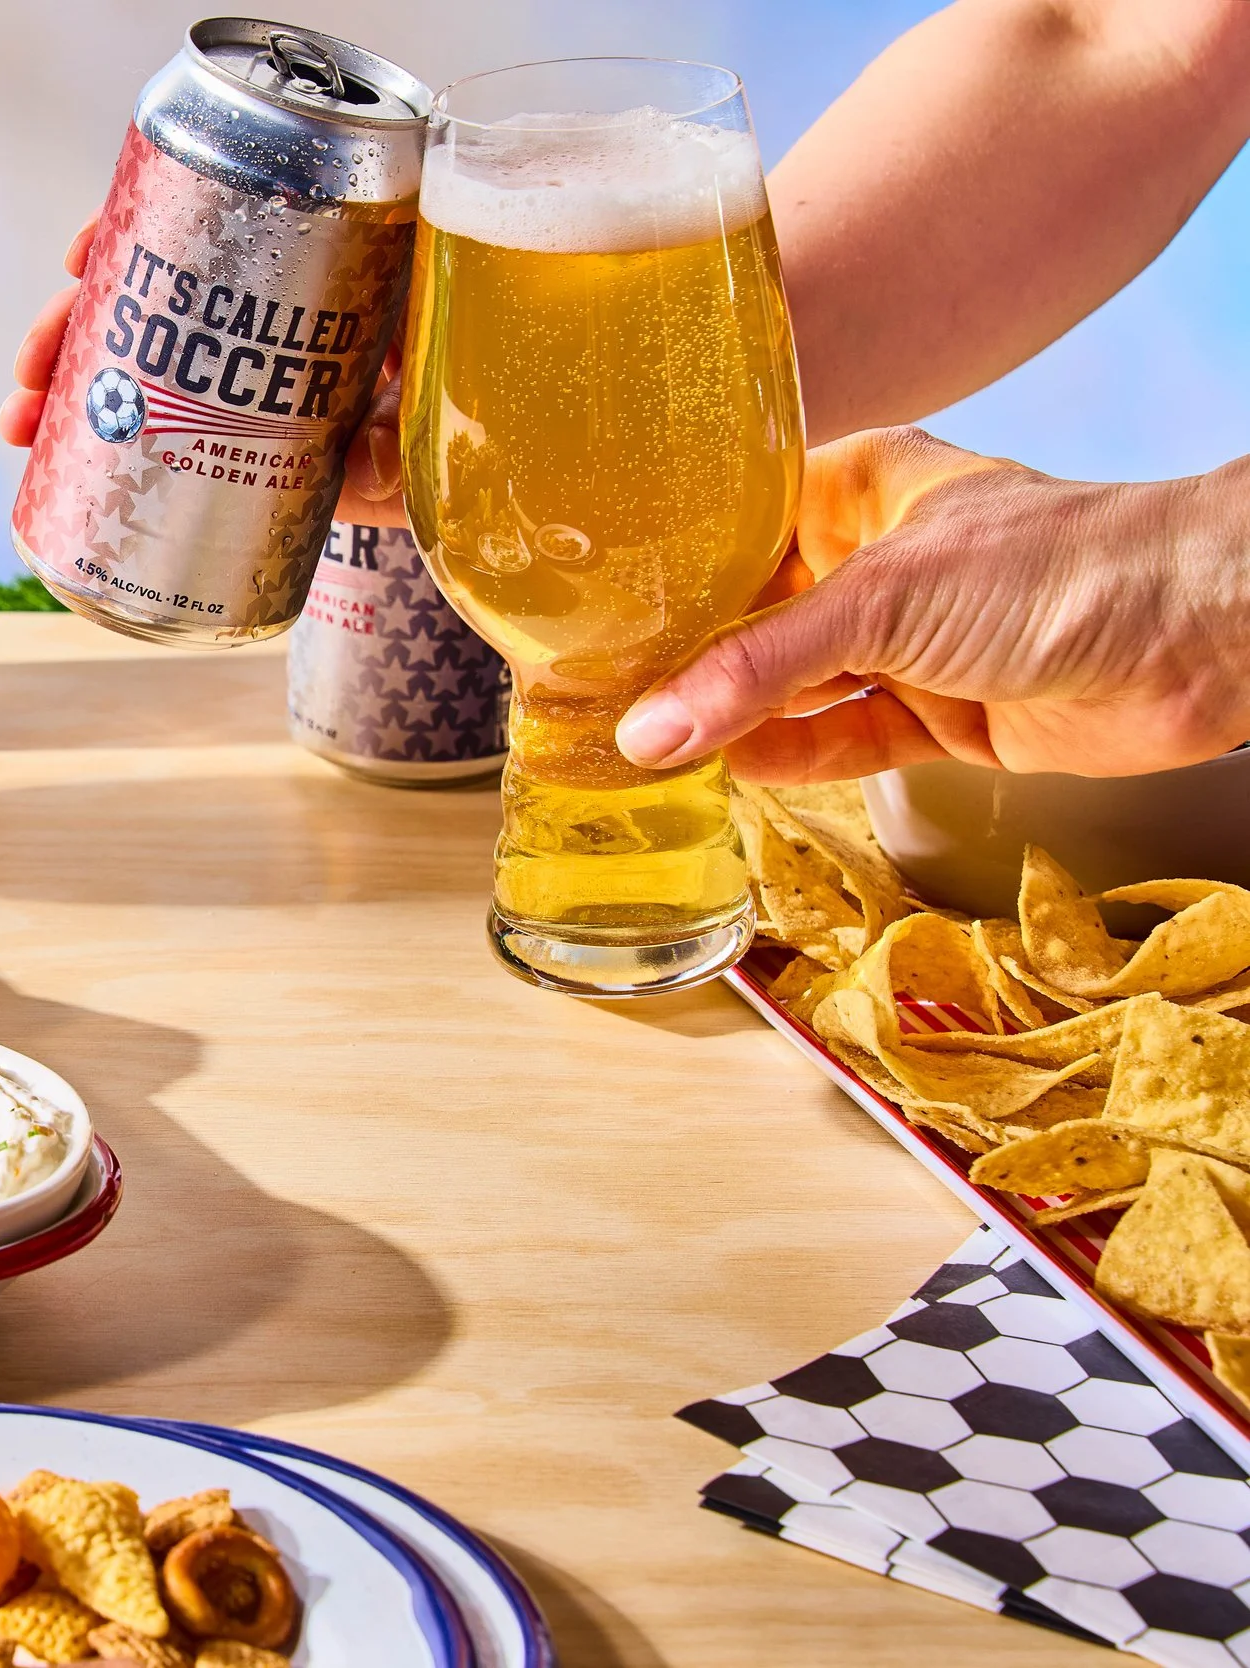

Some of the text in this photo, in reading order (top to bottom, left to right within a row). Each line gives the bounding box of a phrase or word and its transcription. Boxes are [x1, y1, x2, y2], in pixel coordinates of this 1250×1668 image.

[124, 243, 360, 355] IT'S CALLED
[106, 294, 342, 418] SOCCER
[162, 450, 304, 490] GOLDEN ALE
[192, 439, 312, 469] AMERICAN
[75, 557, 224, 614] 4.5% ALC/VOL 12 FL OZ
